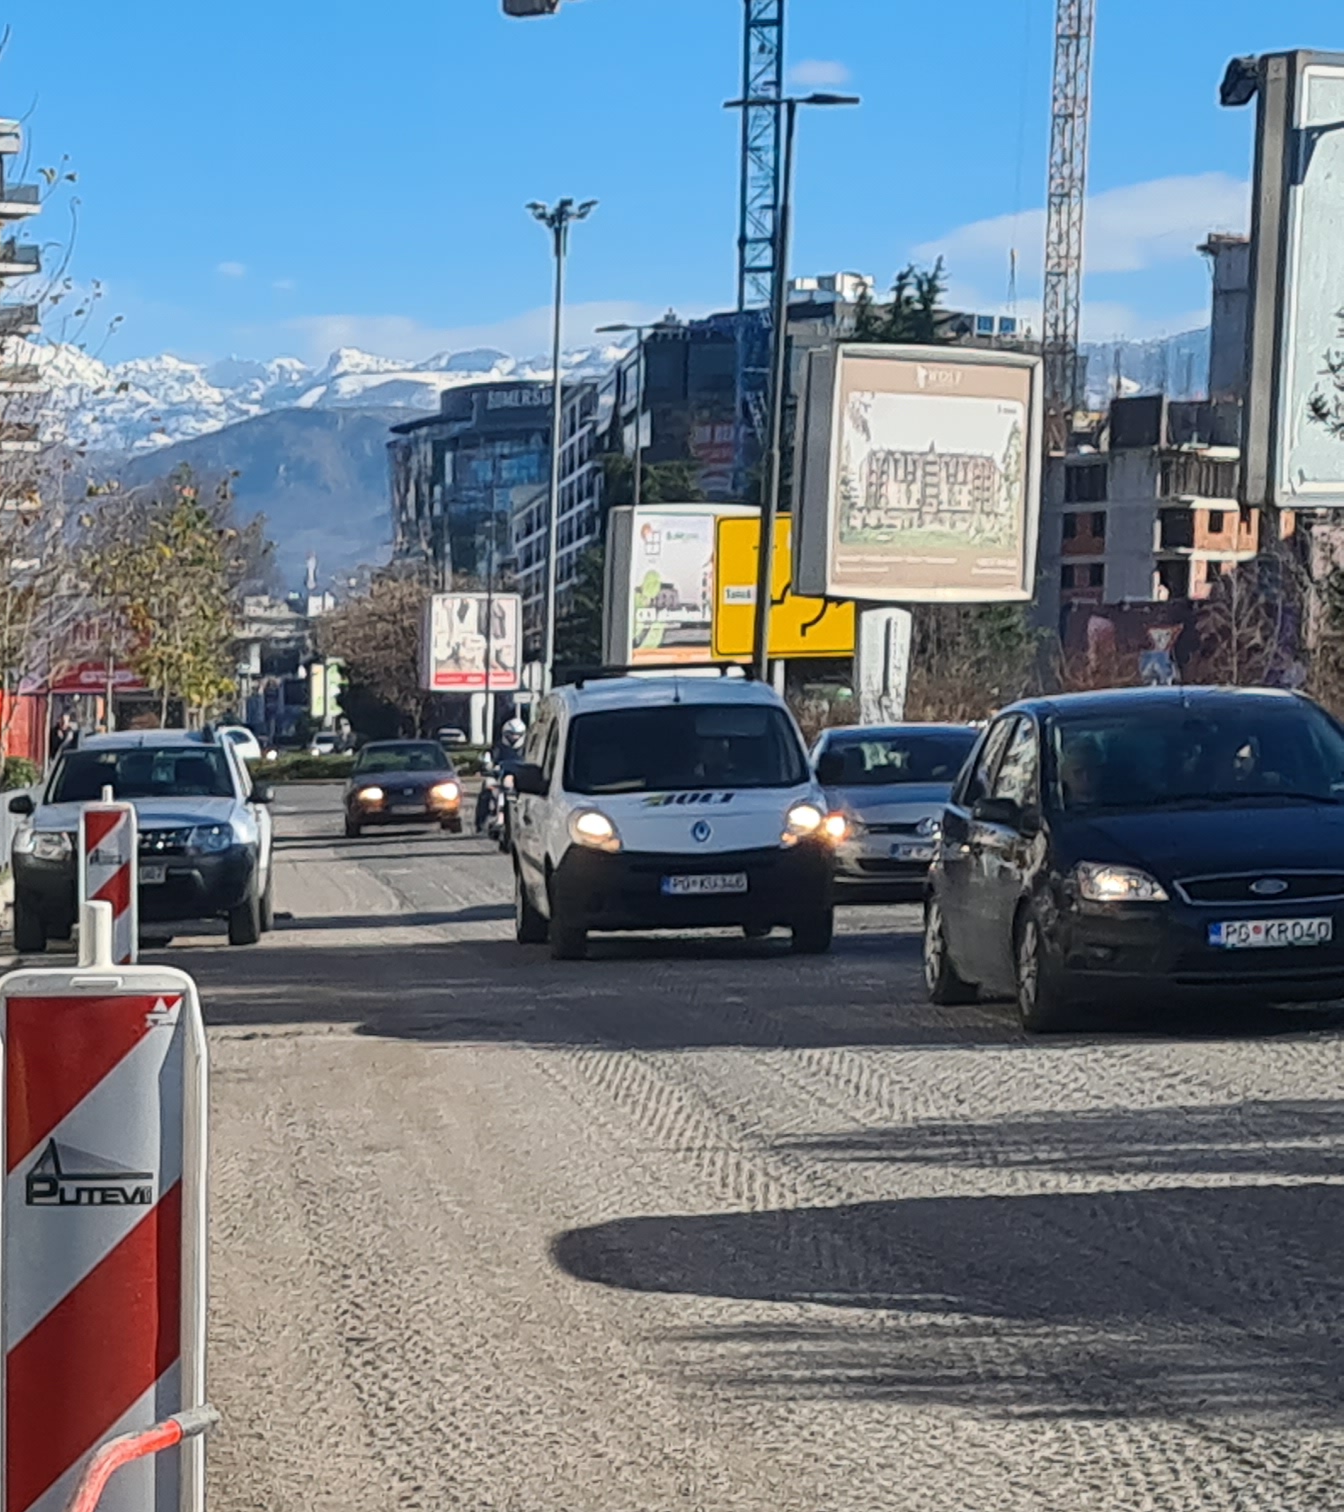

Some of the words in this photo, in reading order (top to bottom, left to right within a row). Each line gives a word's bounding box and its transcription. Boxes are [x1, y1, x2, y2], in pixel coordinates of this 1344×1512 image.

[1225, 923, 1250, 943] PG
[1265, 921, 1330, 941] KR040
[25, 1162, 153, 1206] PUTEVI
